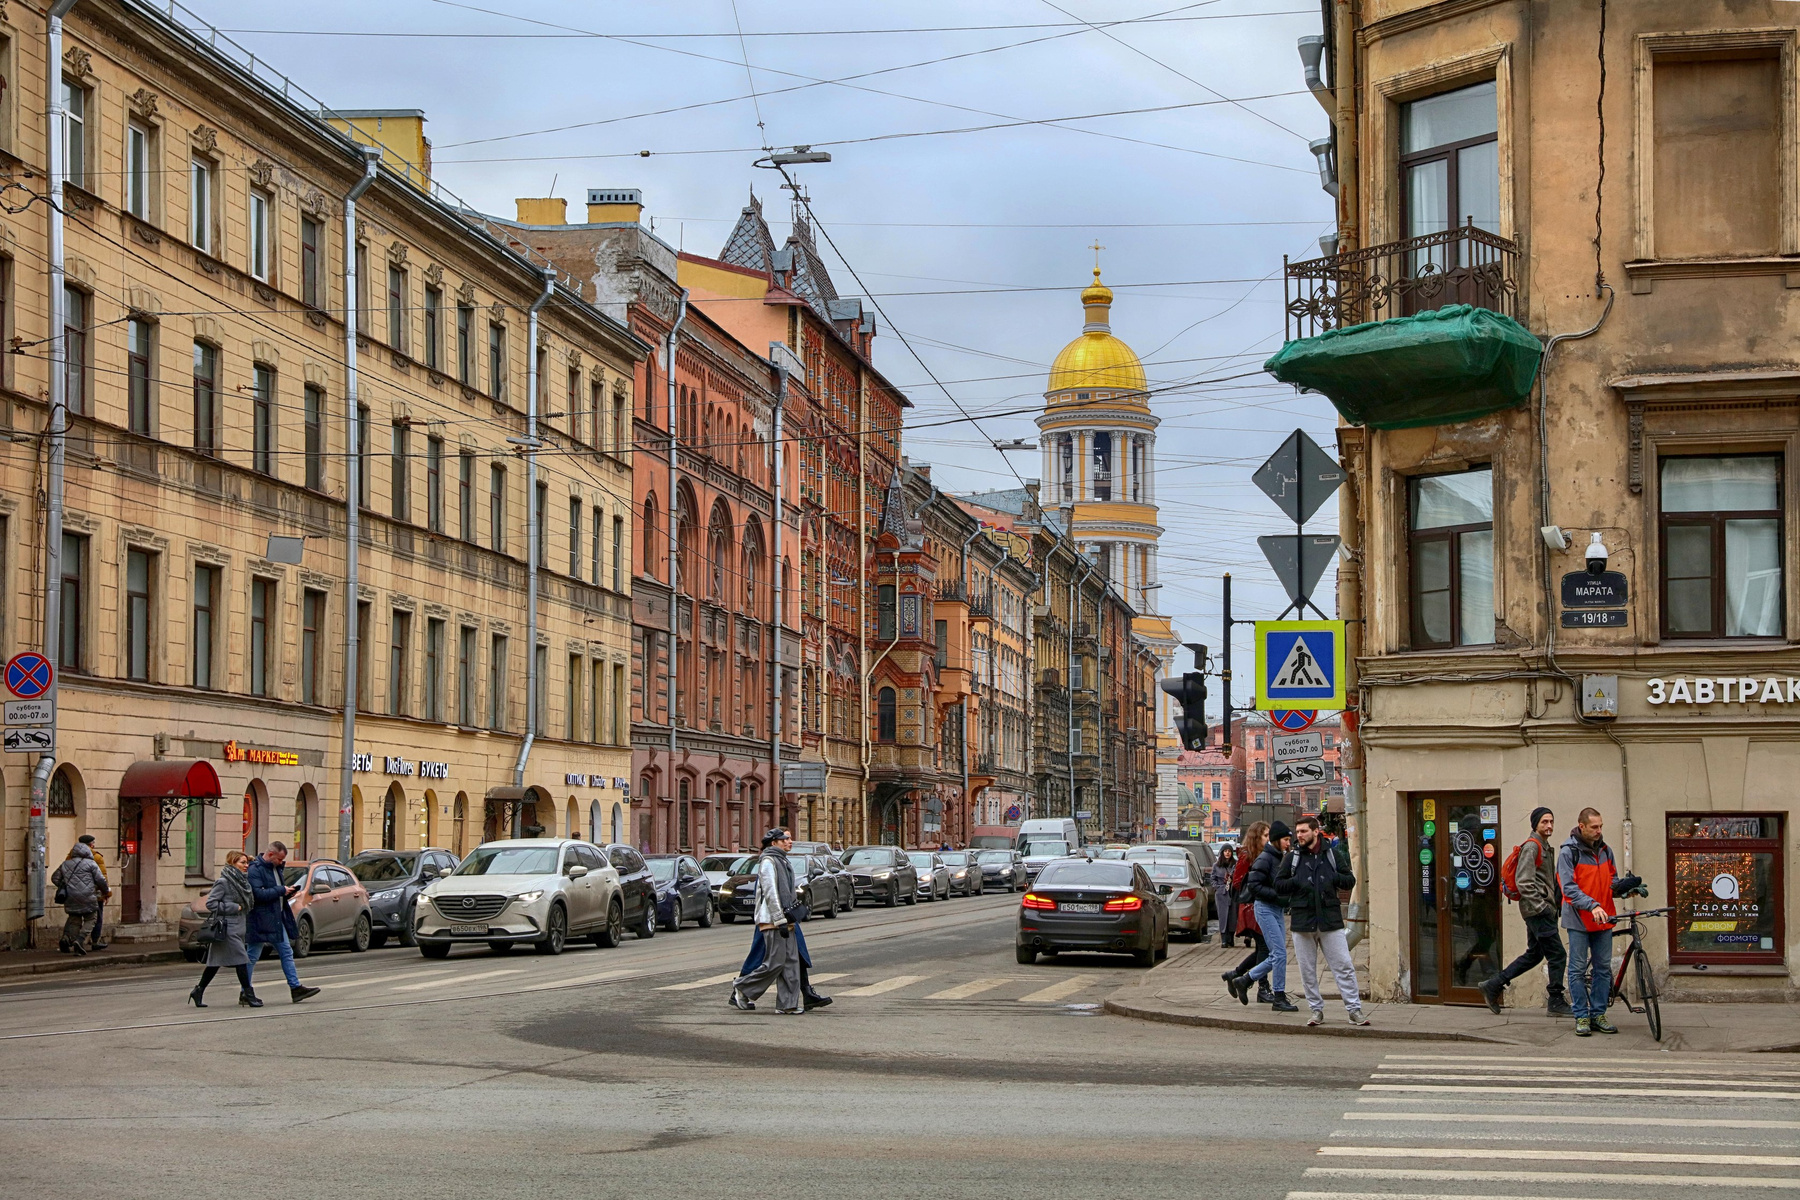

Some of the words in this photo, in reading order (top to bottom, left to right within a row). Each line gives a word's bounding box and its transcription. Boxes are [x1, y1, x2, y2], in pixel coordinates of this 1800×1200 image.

[1576, 586, 1614, 596] МАРАТА
[1582, 613, 1608, 624] 19/18
[352, 753, 373, 772] ВЕТЫ
[420, 761, 449, 778] БУКЕТЫ
[1717, 934, 1758, 943] формате
